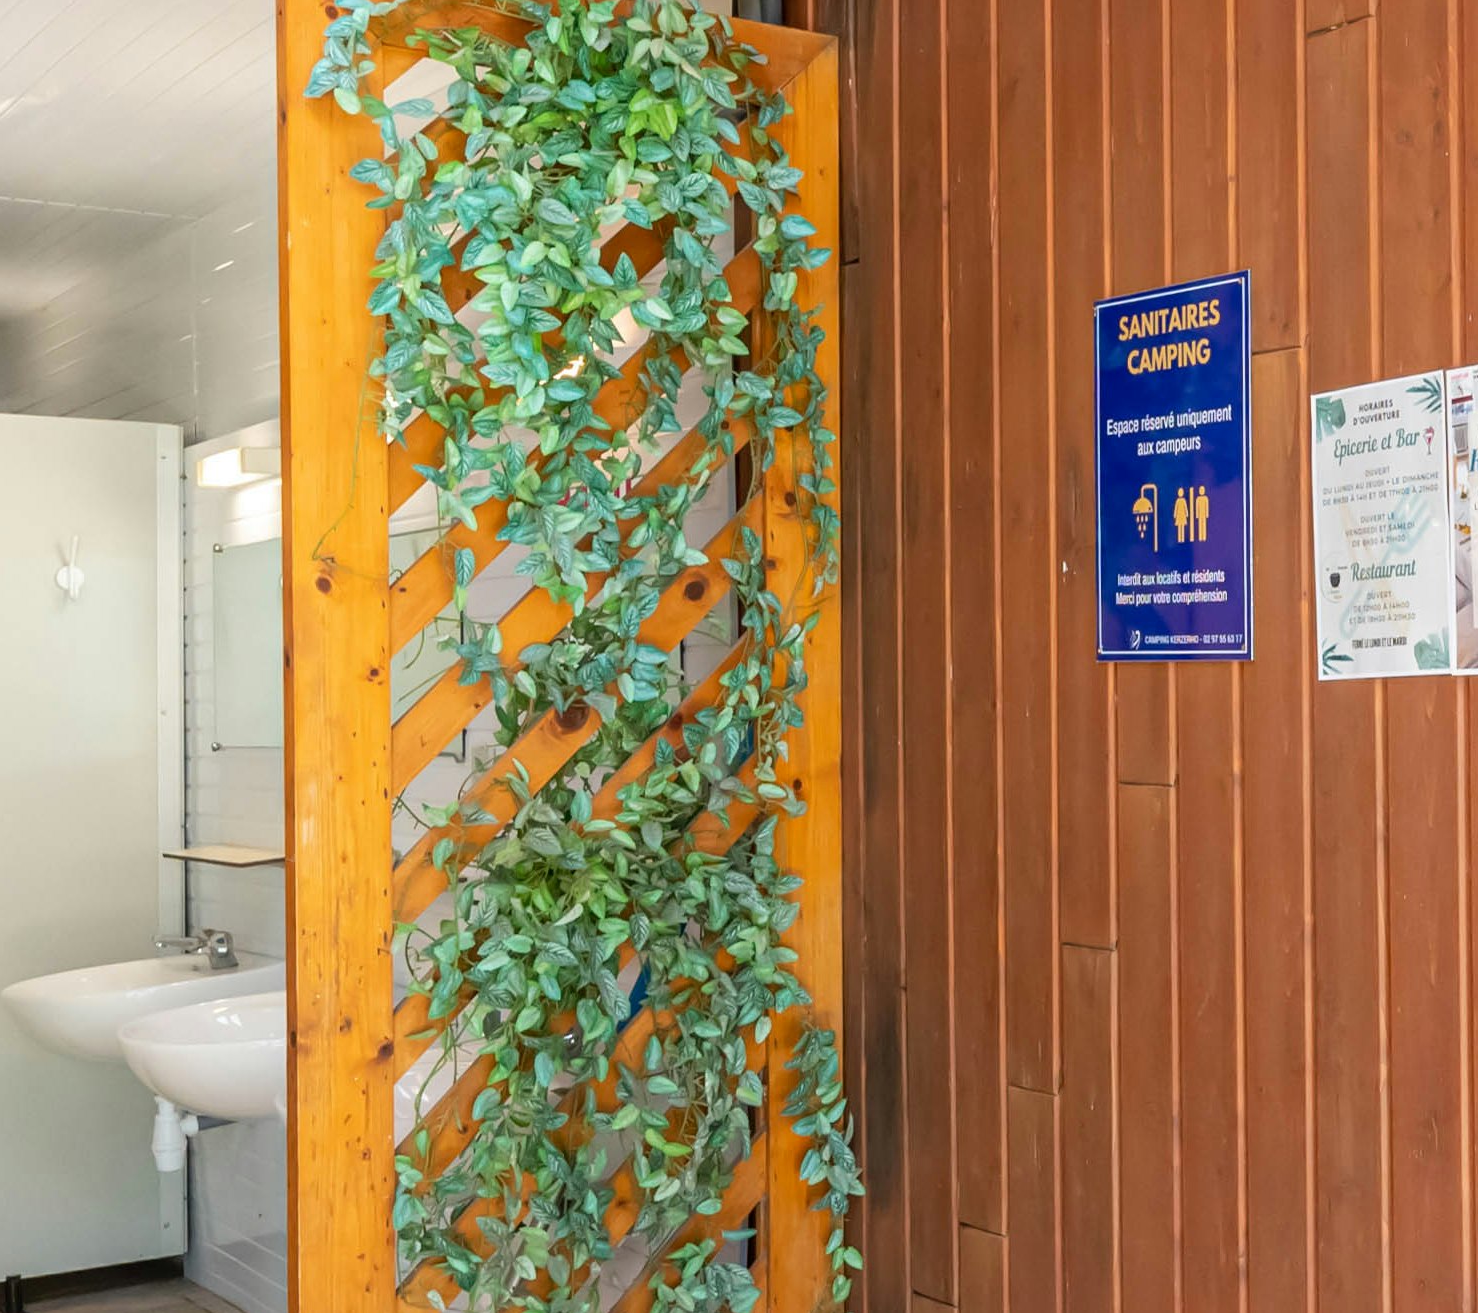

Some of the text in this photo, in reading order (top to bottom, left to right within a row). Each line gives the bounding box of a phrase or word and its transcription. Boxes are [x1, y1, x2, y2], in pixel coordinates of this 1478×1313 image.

[1118, 299, 1220, 341] SANITAIRES
[1127, 338, 1211, 375] CAMPING
[1359, 399, 1393, 412] HORAIRES
[1107, 404, 1232, 437] Espace réservé uniquement
[1353, 410, 1400, 426] D'OUVERTURE
[1137, 436, 1201, 456] aux campeurs
[1334, 428, 1420, 466] Epicerie et Bar
[1365, 466, 1390, 477] OUVERT
[1392, 477, 1399, 485] LE
[1403, 472, 1439, 484] DIMANCHE
[1360, 513, 1385, 523] OUVERT
[1117, 568, 1225, 586] Interdit aux locatifs et résidents
[1350, 560, 1416, 582] Restaurant
[1115, 588, 1227, 606] Merci pour votre compréhension
[1144, 635, 1169, 644] CAMPING
